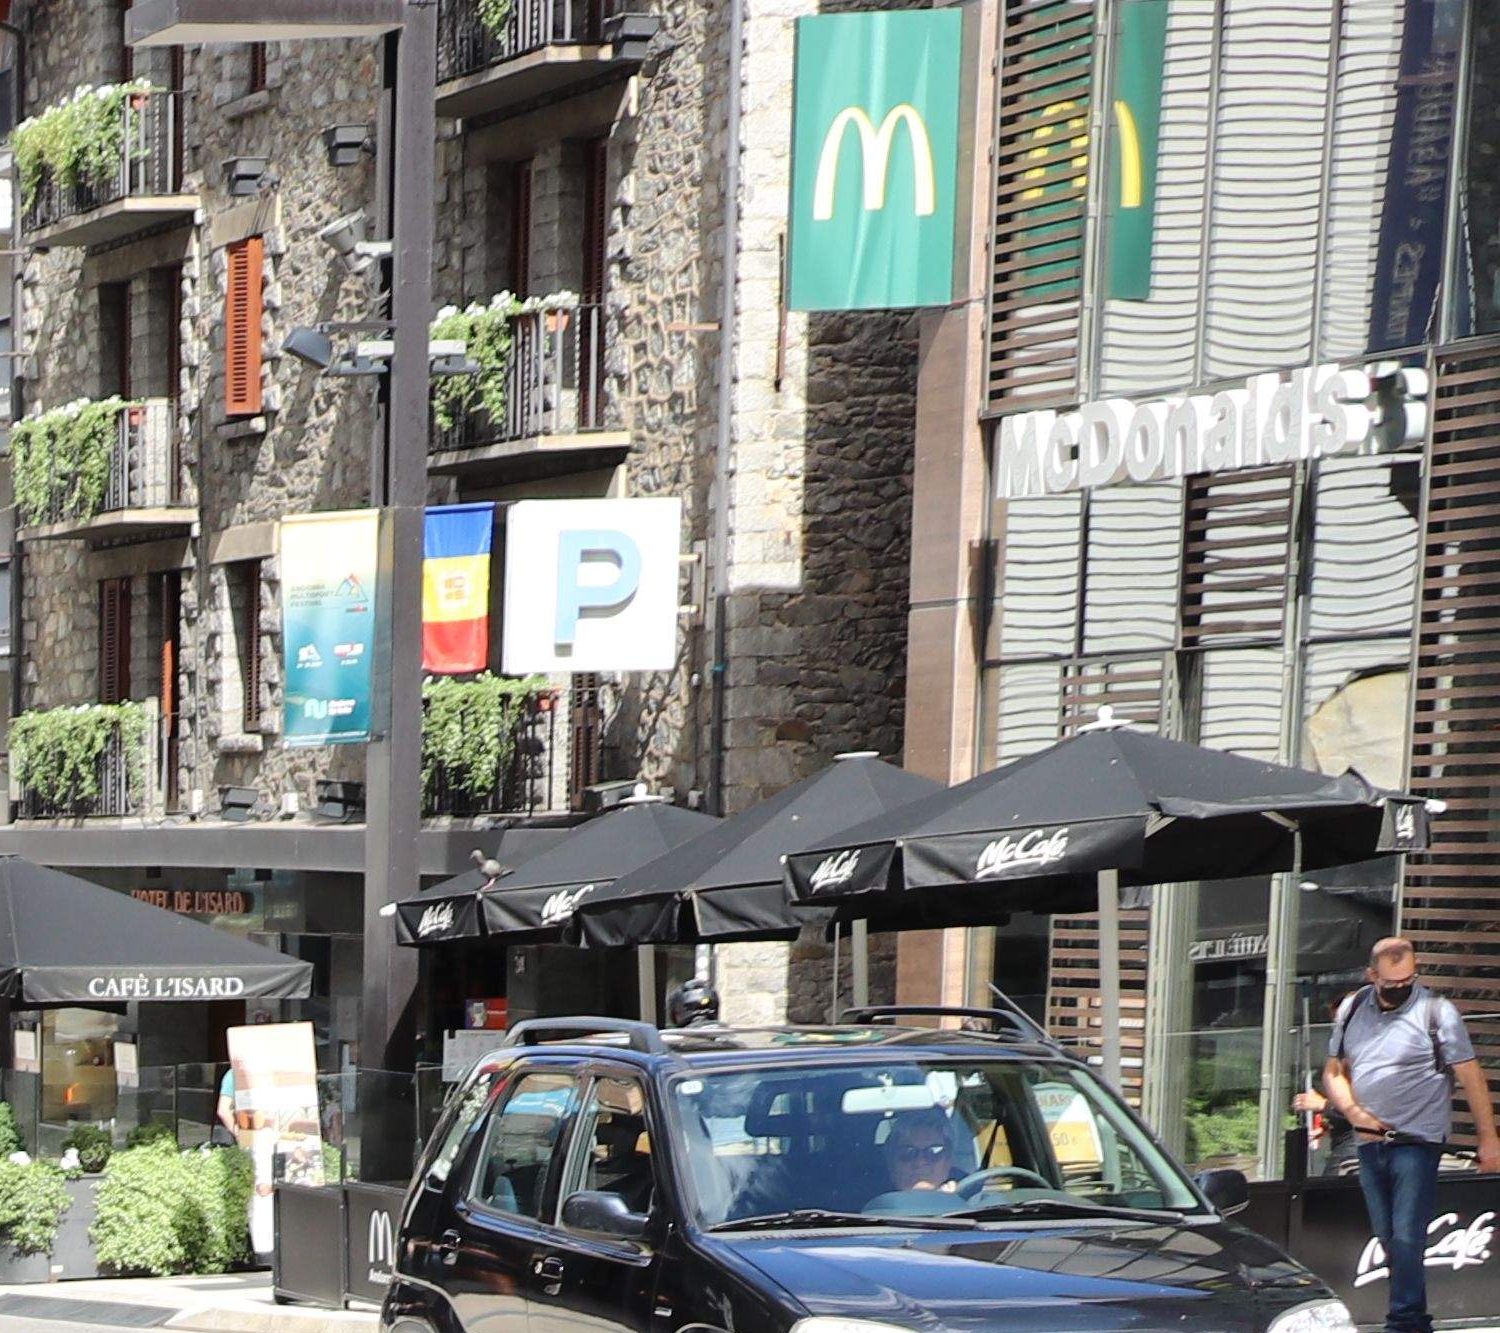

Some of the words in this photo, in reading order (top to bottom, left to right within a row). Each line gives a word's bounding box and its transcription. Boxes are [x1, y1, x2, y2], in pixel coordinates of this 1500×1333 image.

[553, 529, 642, 656] P
[975, 828, 1069, 879] McCafé
[174, 891, 192, 913] DE
[155, 977, 245, 998] L'ISARD
